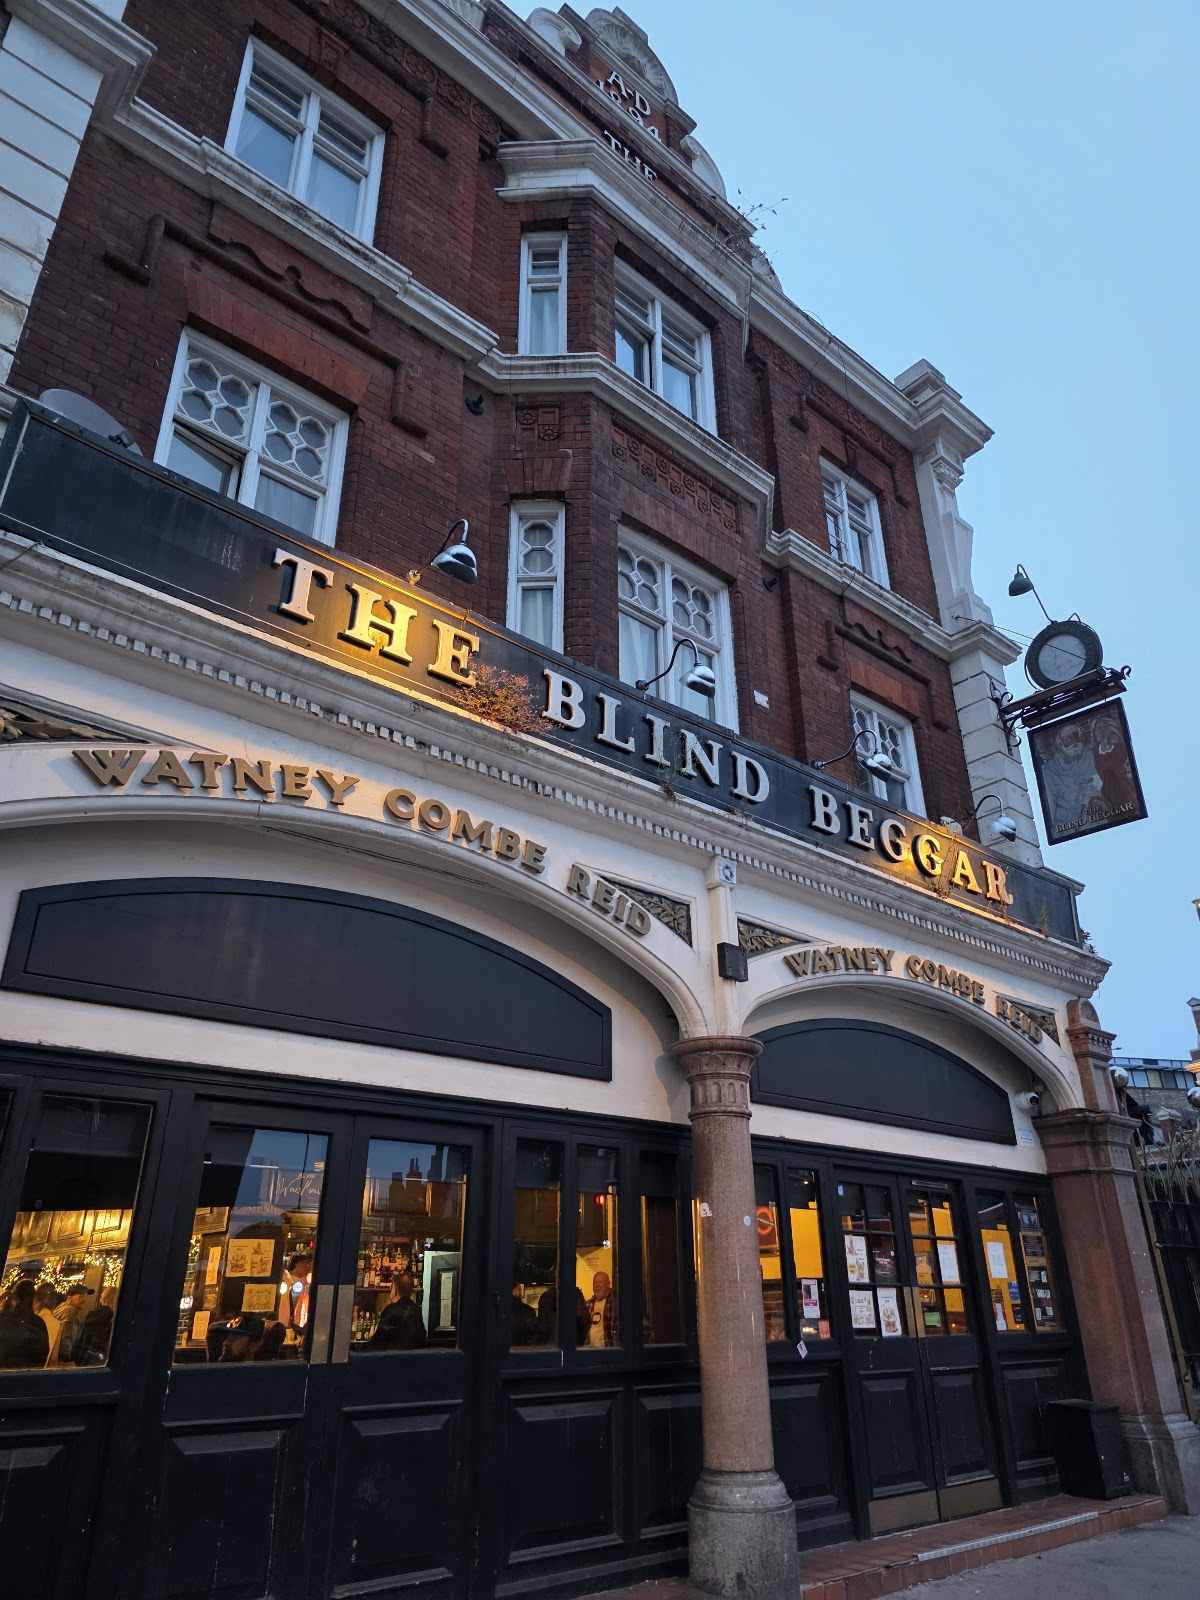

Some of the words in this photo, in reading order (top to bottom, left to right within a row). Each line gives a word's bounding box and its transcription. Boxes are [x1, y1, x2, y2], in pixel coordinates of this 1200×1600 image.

[603, 129, 658, 182] THE
[272, 547, 481, 688] THE
[540, 668, 770, 804] BLIND
[808, 784, 1014, 905] BEGGAR
[72, 749, 360, 806] WATNEY
[384, 788, 548, 874] COMBE
[566, 863, 652, 936] REID
[1055, 817, 1088, 834] BLIND
[1089, 802, 1134, 823] BEGGAR
[1083, 805, 1103, 816] THE
[783, 945, 896, 978] WATNEY
[905, 954, 986, 1005] COMBE
[995, 994, 1043, 1044] REID
